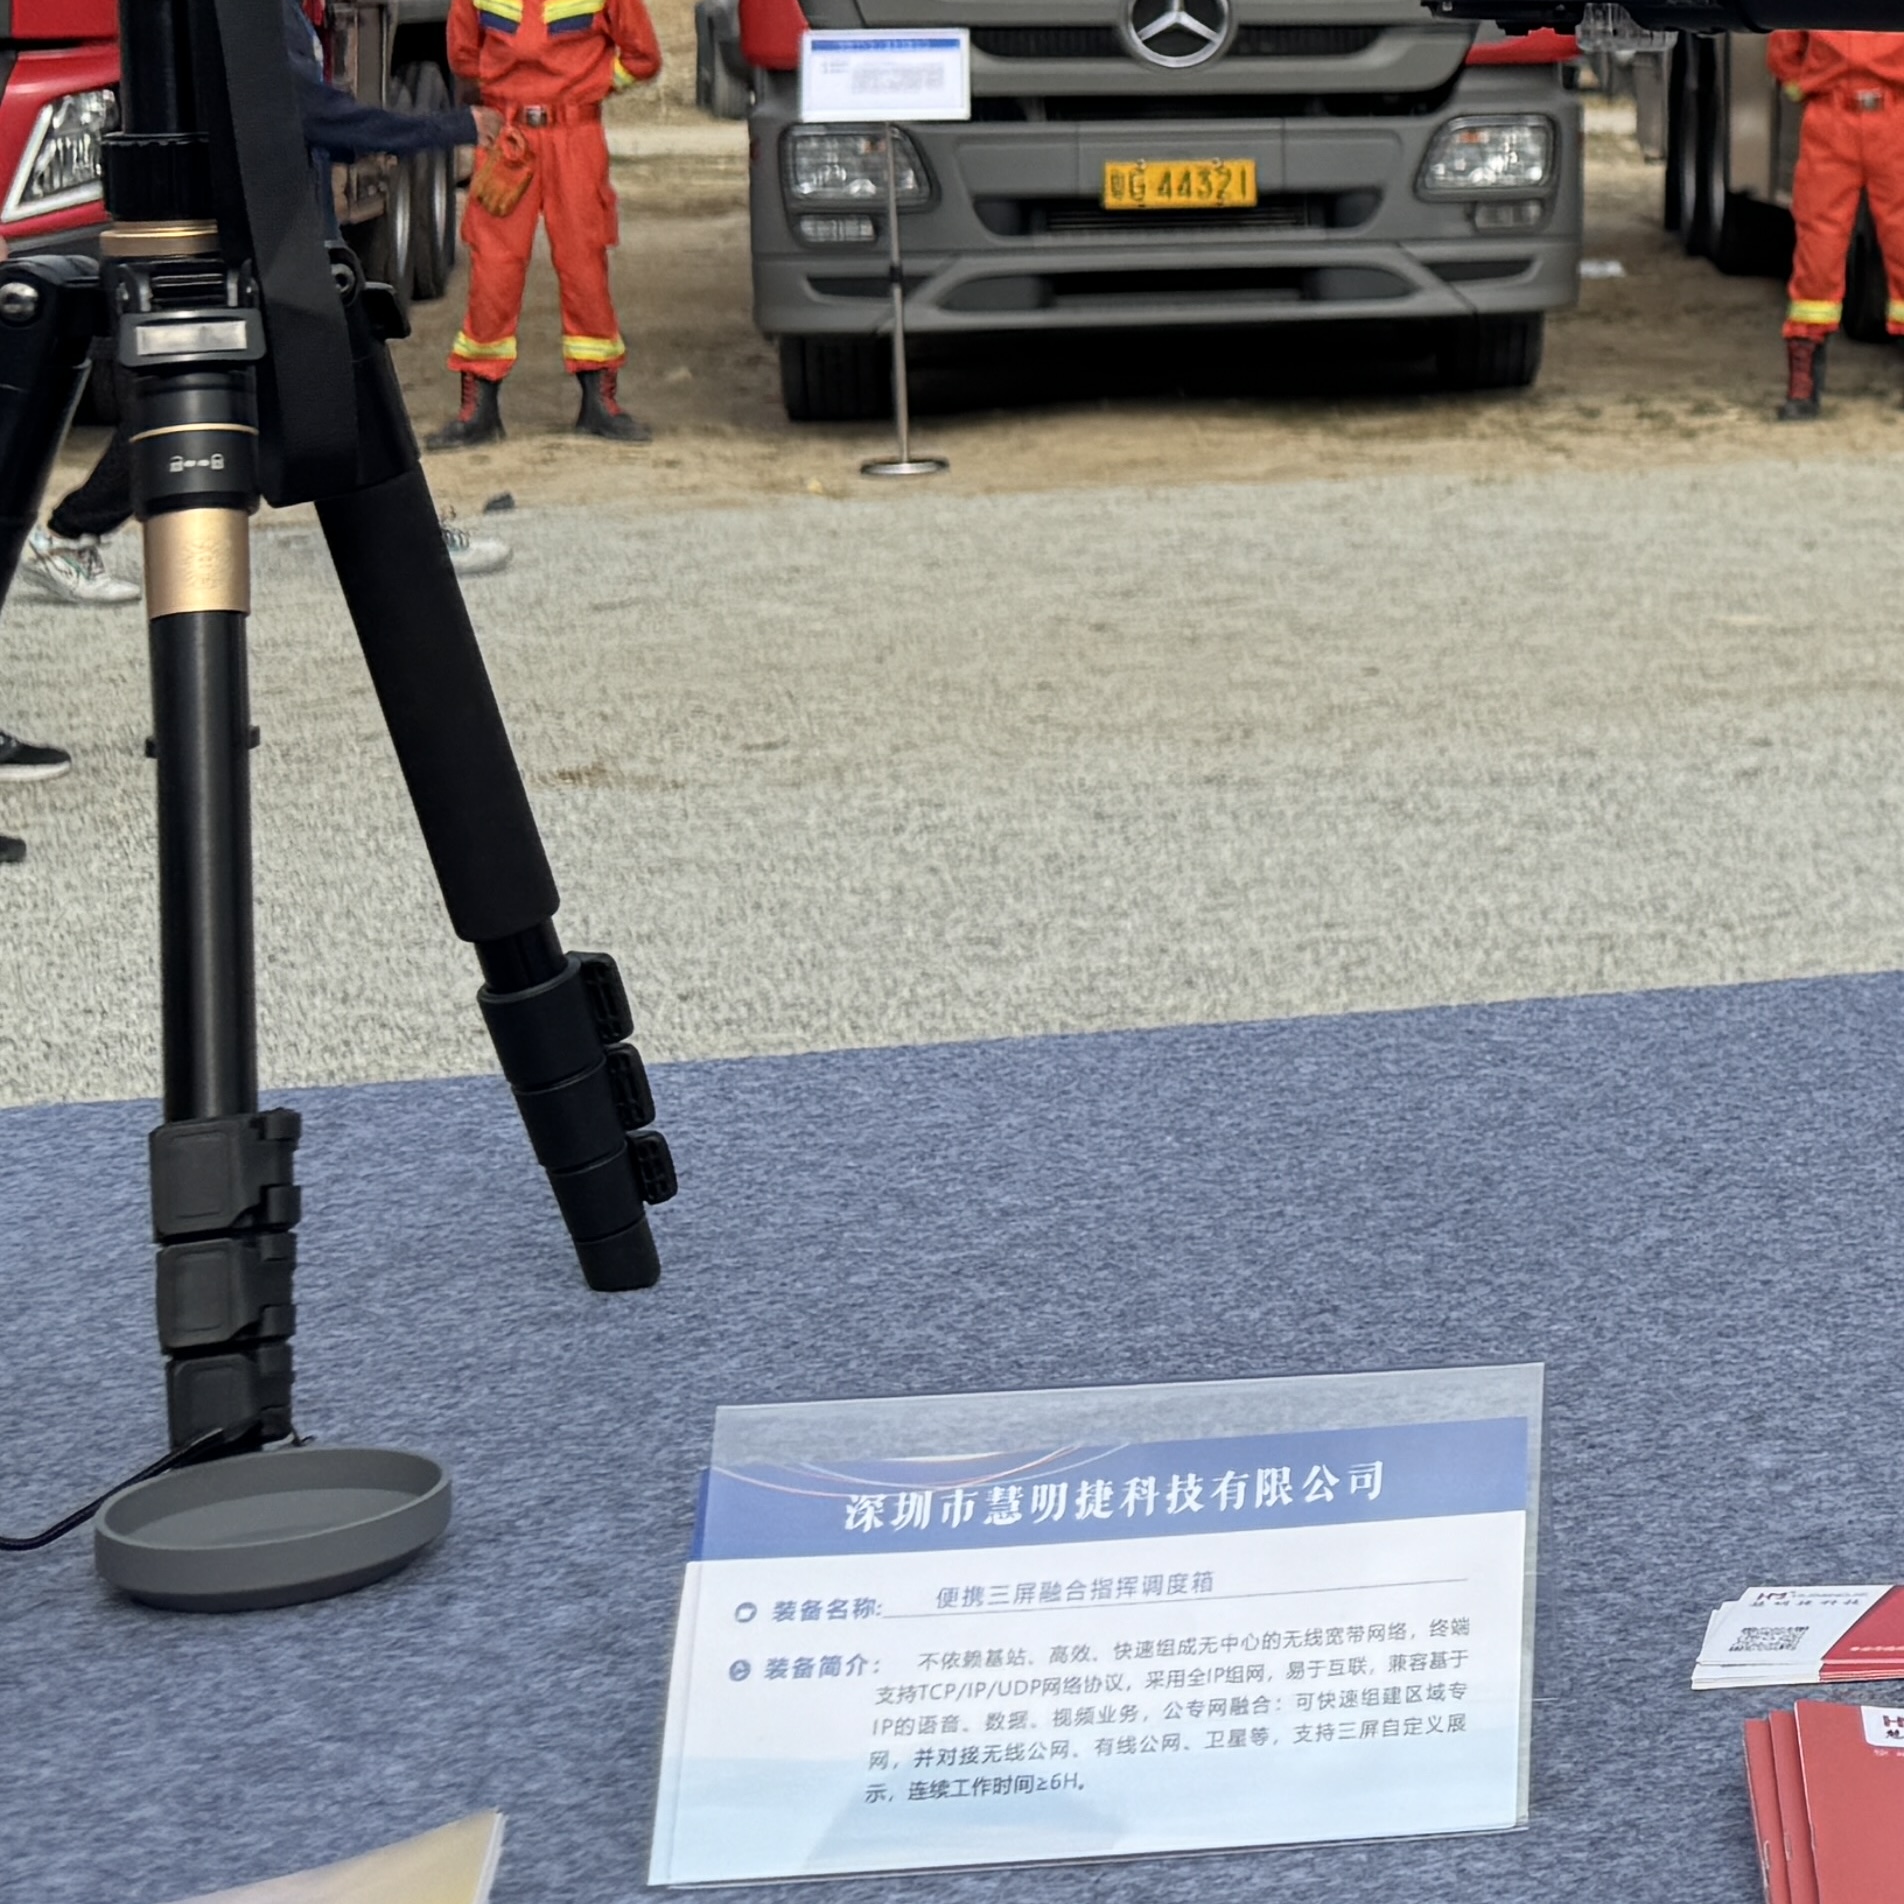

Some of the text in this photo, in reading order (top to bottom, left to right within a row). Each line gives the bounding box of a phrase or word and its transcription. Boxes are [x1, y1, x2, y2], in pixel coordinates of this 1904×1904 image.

[843, 1459, 1384, 1533] 深圳市慧明捷科技有限公司
[935, 1570, 1216, 1609] 便携三屏融合指挥调度箱
